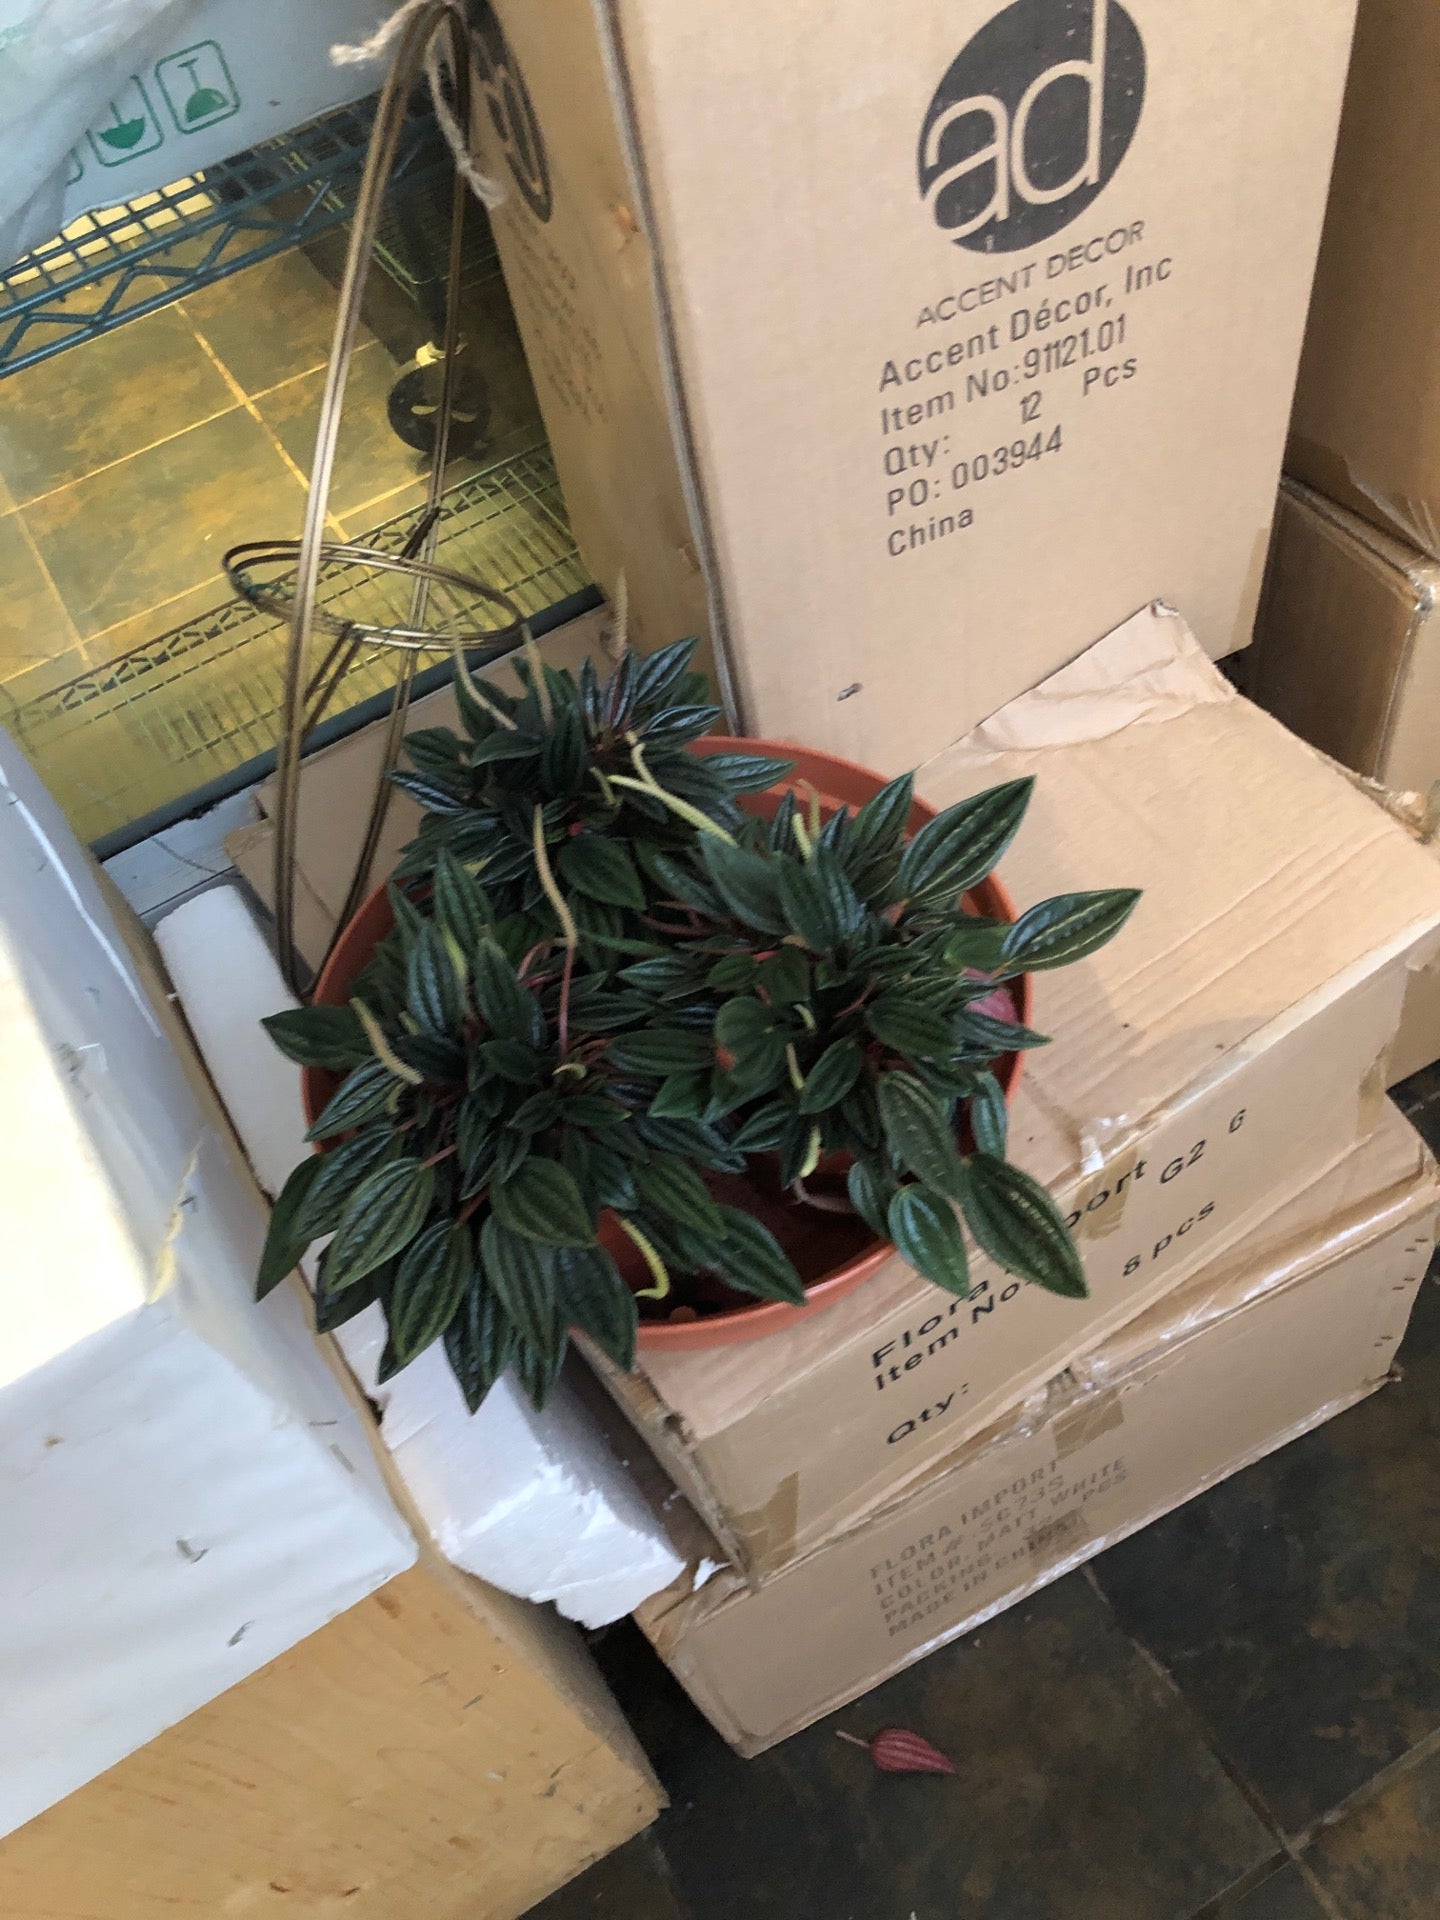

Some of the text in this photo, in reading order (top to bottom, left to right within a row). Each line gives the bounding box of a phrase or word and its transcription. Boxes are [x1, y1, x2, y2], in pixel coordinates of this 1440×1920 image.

[922, 0, 1109, 241] ad
[878, 257, 1172, 392] Accent Décor, Inc
[916, 220, 1145, 329] ACCENT DECOR
[880, 390, 955, 435] Item
[883, 357, 1137, 477] Qty: 12 Pcs
[887, 424, 1063, 517] PO: 003944
[887, 508, 974, 556] China
[875, 1327, 959, 1391] Item
[1160, 1140, 1206, 1185] G2
[872, 1280, 989, 1368] Flora
[886, 1200, 1215, 1445] Qty: 8 pcs
[870, 1459, 1058, 1579] FLORA IMPORT
[1049, 1456, 1125, 1506] WHITE
[964, 1569, 988, 1592] IN
